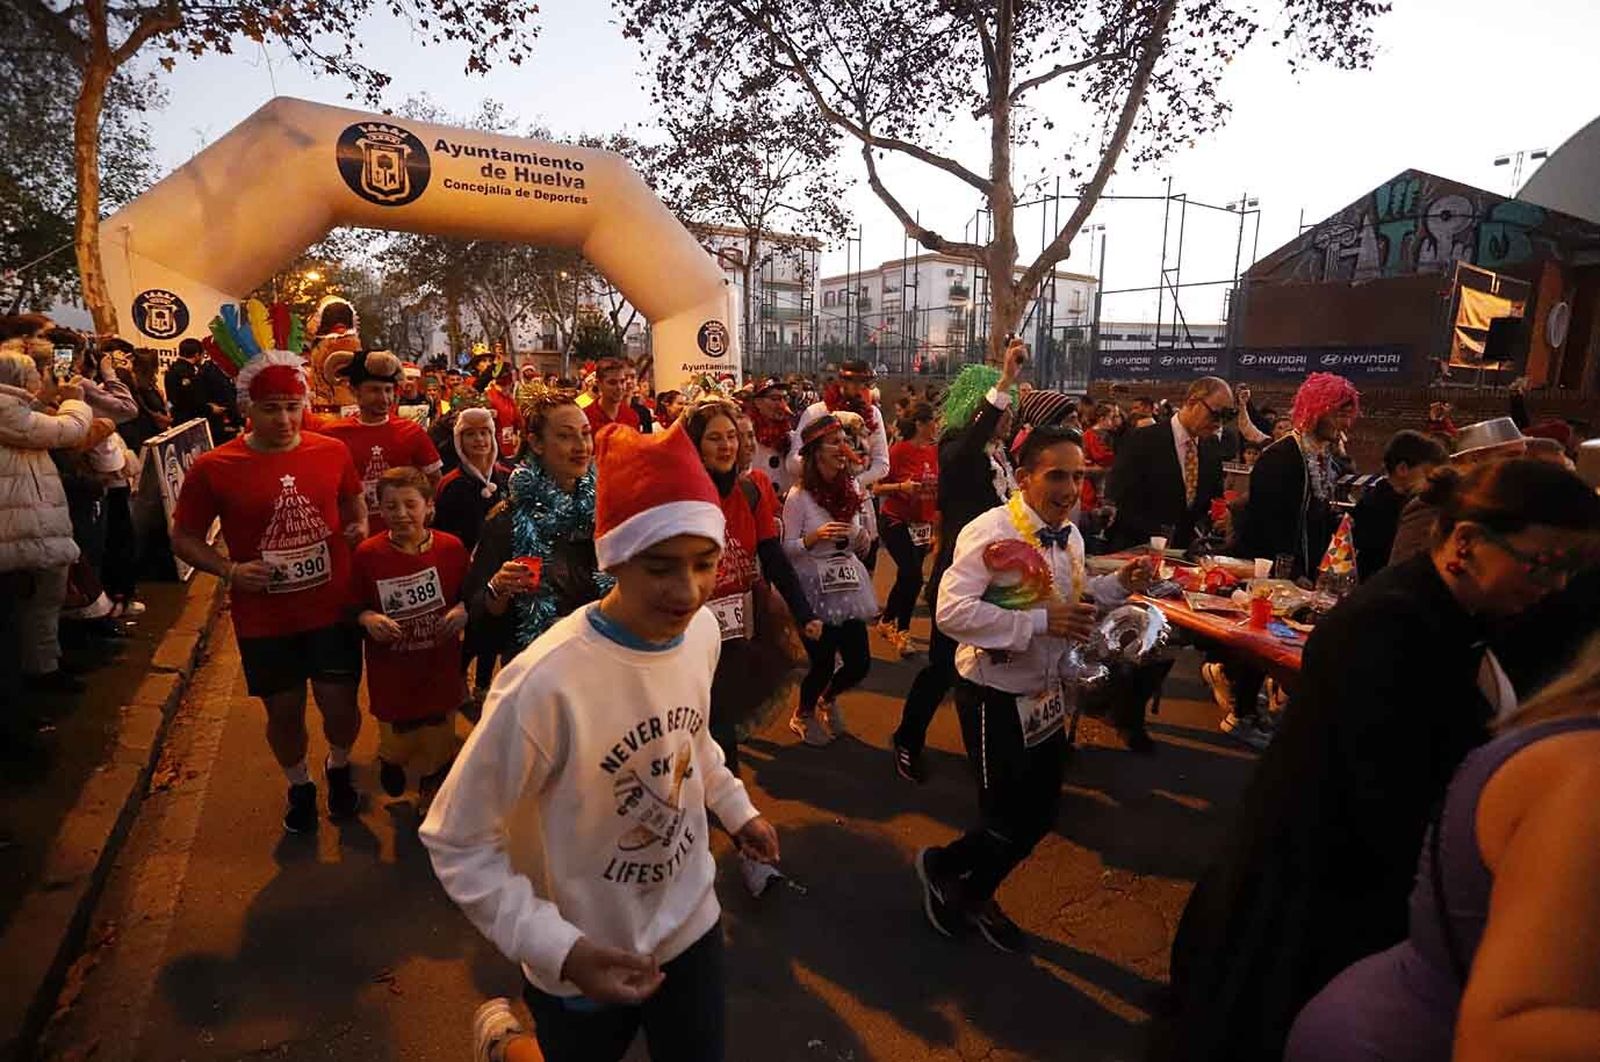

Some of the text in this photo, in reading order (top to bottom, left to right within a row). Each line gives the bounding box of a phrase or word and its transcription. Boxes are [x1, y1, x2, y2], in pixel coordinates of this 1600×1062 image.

[433, 138, 585, 172] Ayuntamiento
[480, 162, 586, 190] de Huelva
[515, 187, 531, 198] de
[534, 189, 589, 205] Deportes
[1115, 356, 1151, 365] HYUNDAI
[1175, 355, 1218, 365] HYUNDAI
[1257, 354, 1308, 365] HYUNDAI
[1342, 353, 1401, 364] HYUNDAI
[293, 556, 325, 578] 390
[838, 566, 857, 580] 432
[406, 582, 437, 605] 389
[1042, 694, 1061, 721] 456
[599, 716, 665, 775] NEVER
[602, 825, 697, 884] LIFESTYLE
